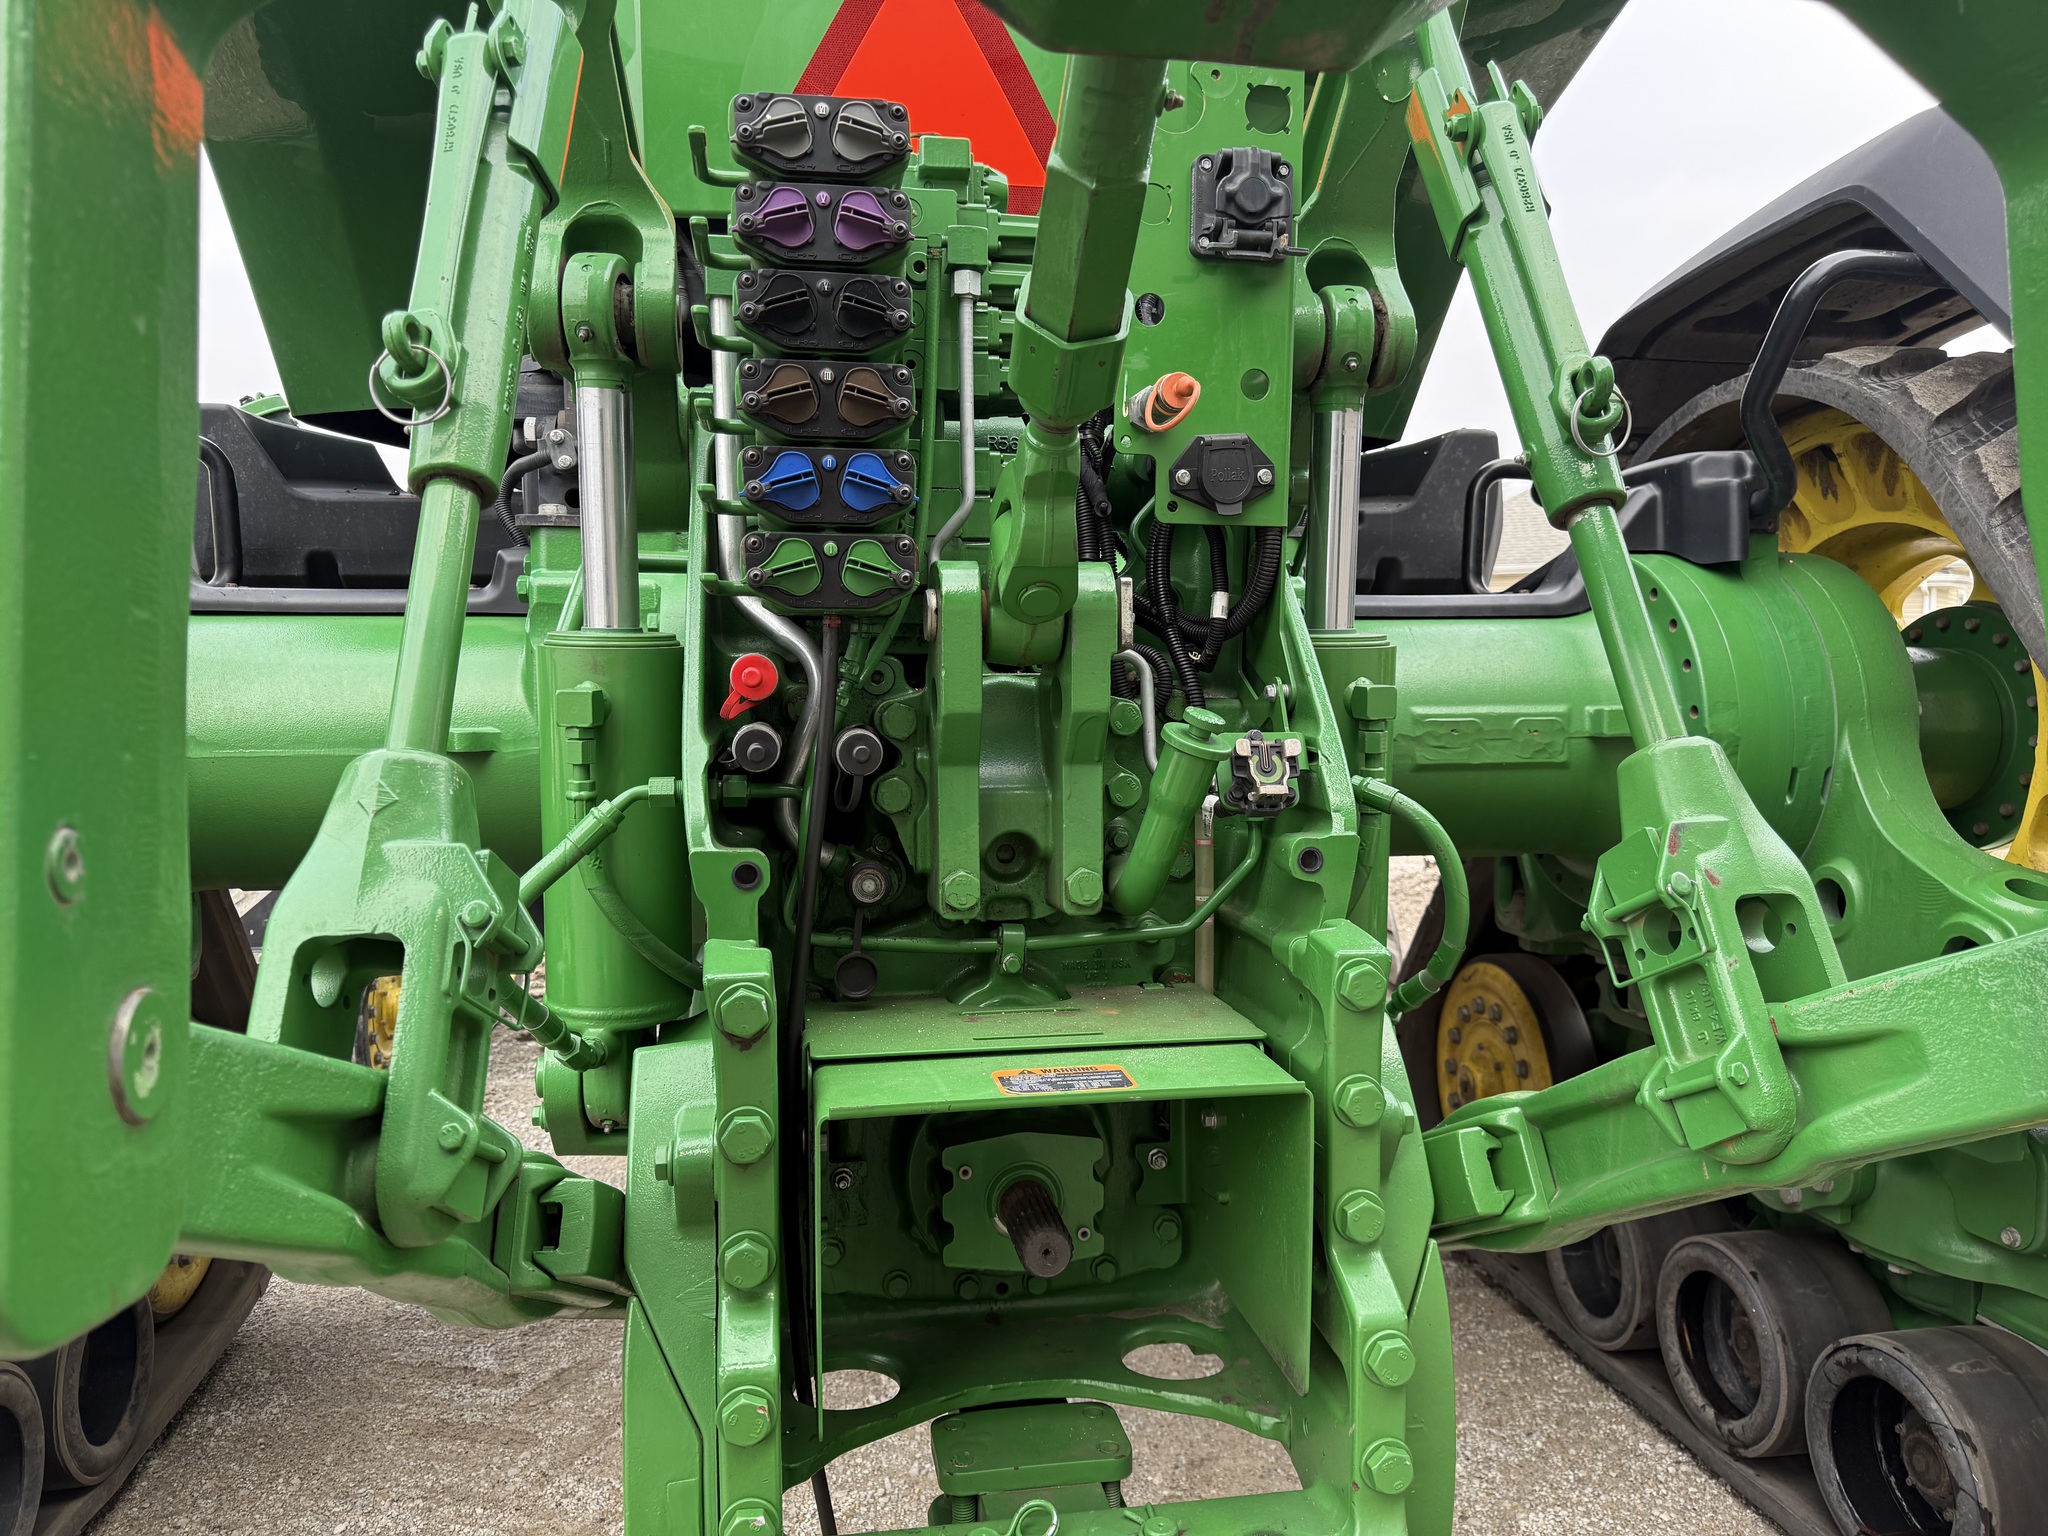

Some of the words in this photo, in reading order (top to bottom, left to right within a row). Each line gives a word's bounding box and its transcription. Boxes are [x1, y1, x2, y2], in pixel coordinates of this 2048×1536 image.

[1501, 124, 1516, 145] USA
[1210, 467, 1246, 483] Pollak
[1111, 958, 1131, 969] USA
[1040, 1066, 1099, 1074] WARNING
